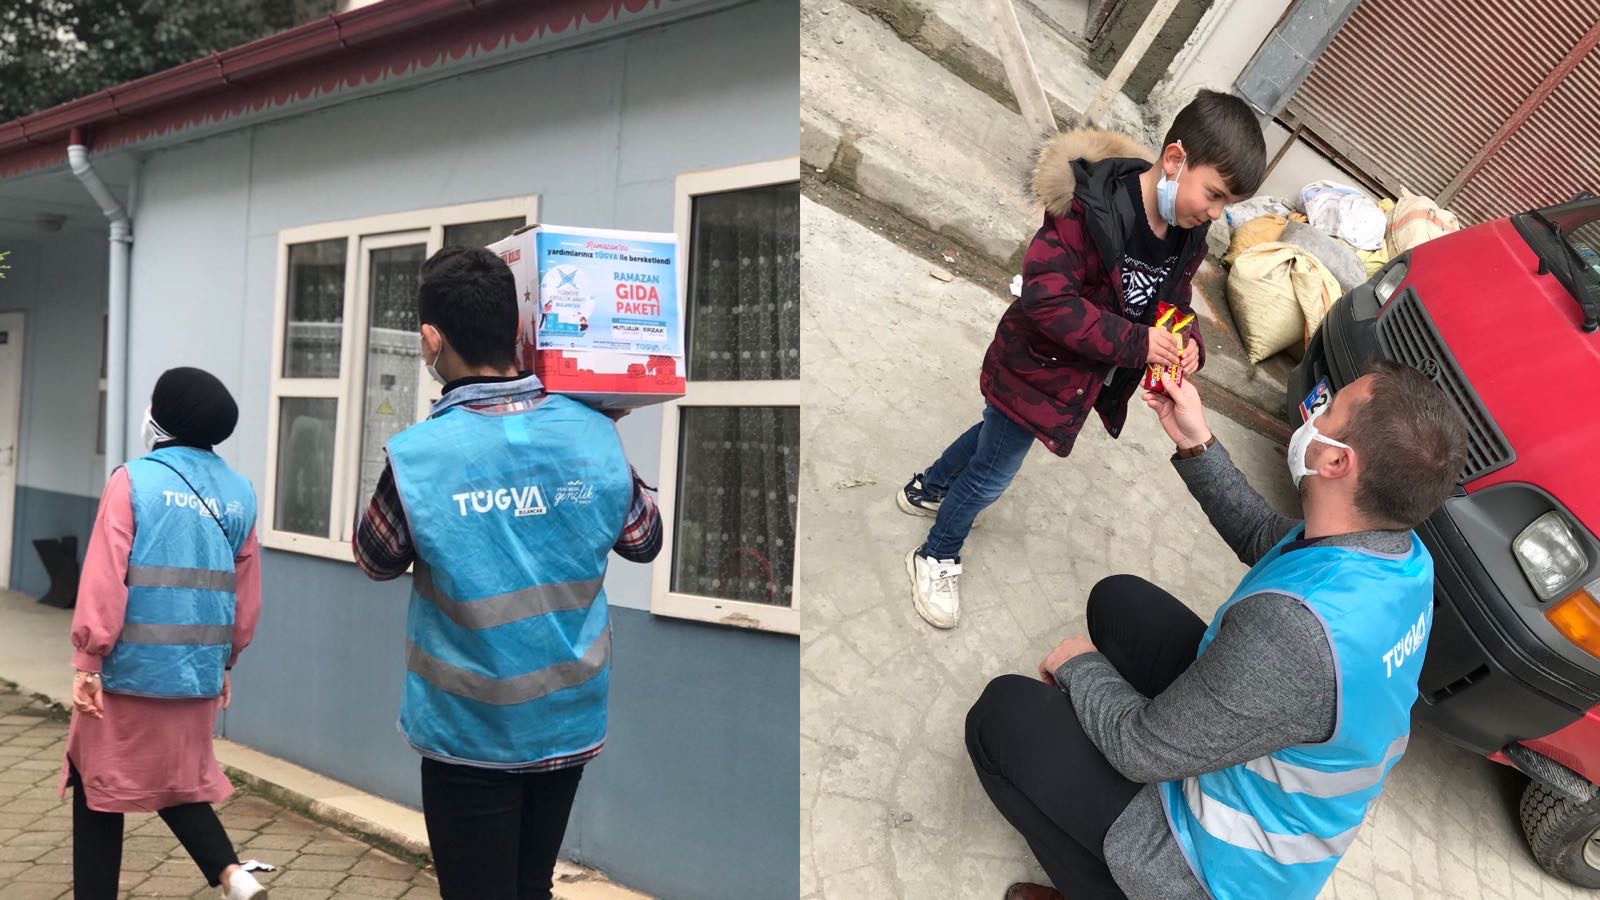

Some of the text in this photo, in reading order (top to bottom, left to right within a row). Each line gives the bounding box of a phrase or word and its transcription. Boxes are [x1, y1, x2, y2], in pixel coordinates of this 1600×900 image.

[547, 248, 593, 259] yardımlarınız
[619, 253, 628, 261] ile
[629, 255, 671, 265] bereketlendi
[613, 271, 660, 284] RAMAZAN
[615, 283, 660, 301] GIDA
[452, 485, 545, 517] TÜGVA
[553, 484, 594, 507] gençlik
